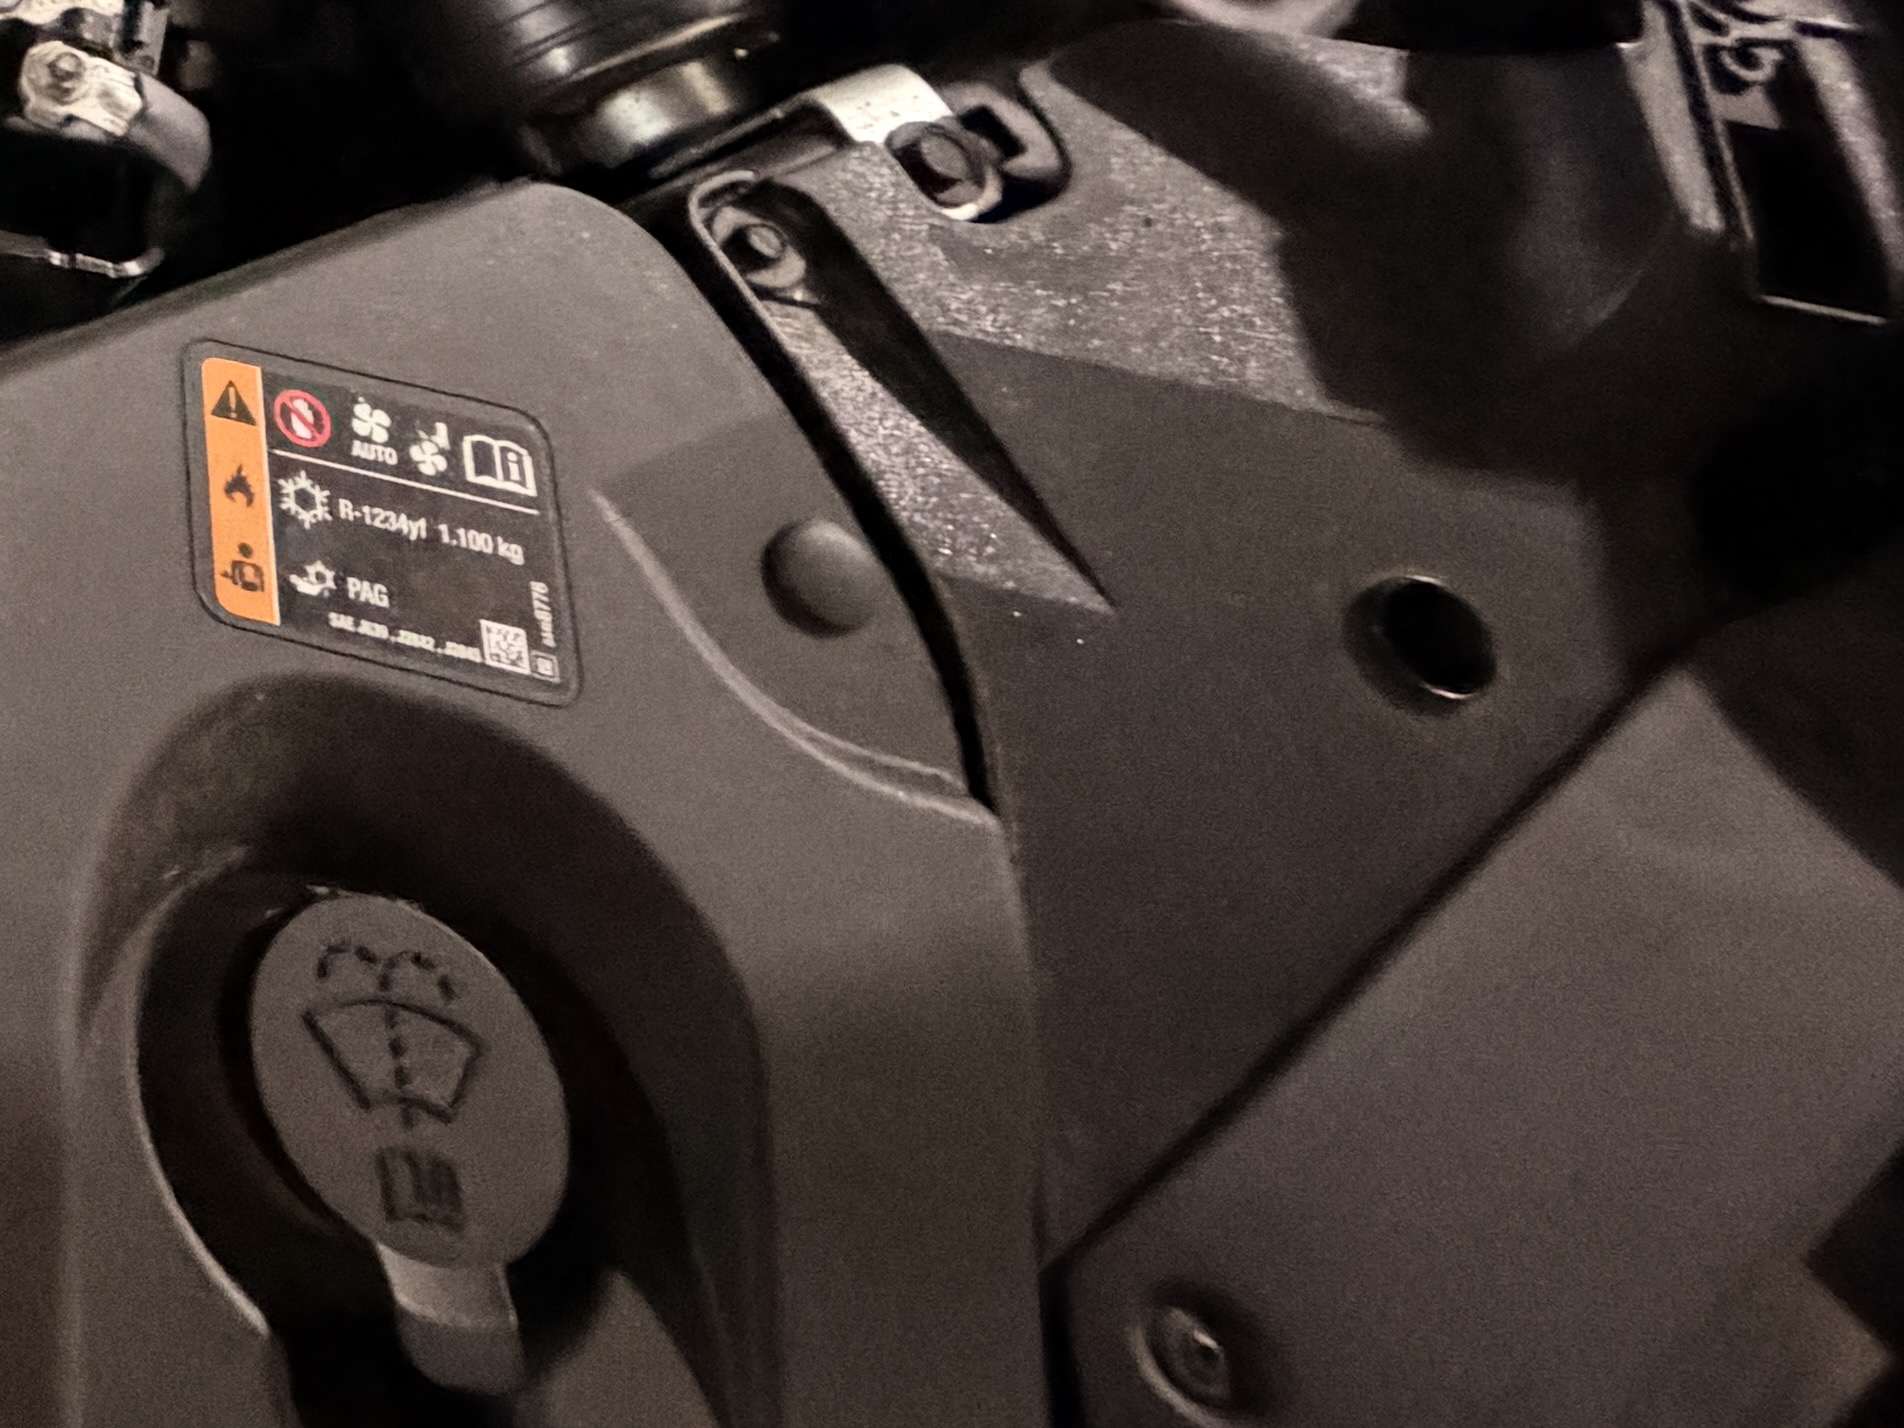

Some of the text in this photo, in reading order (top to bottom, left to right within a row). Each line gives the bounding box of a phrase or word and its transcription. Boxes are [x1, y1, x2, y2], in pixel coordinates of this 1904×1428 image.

[351, 439, 399, 466] AUTO
[437, 523, 495, 555] 1.100
[496, 535, 526, 566] kg
[346, 576, 390, 609] PAG
